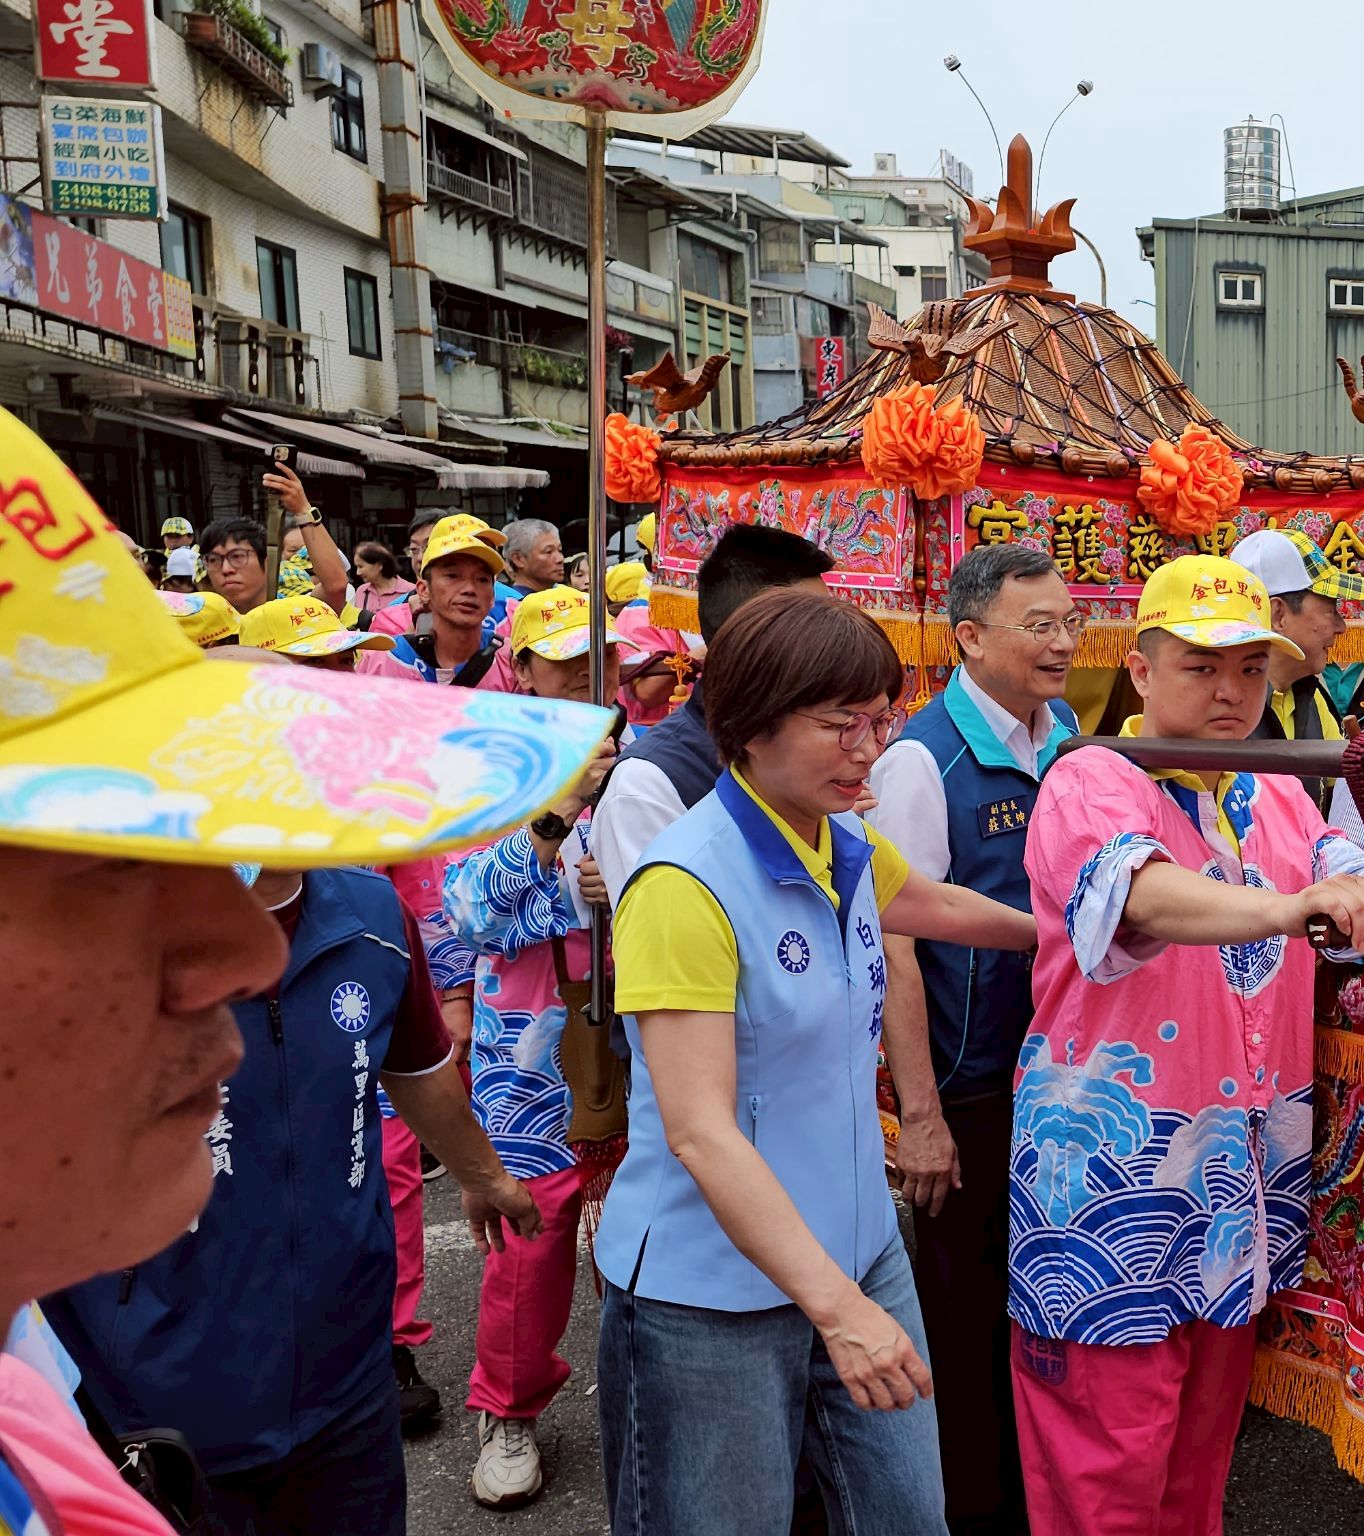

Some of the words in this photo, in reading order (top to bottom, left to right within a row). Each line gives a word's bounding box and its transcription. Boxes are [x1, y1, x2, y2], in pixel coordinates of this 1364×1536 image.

[49, 0, 134, 78] 堂
[51, 104, 147, 124] 台菜海鮮
[53, 142, 150, 163] 經濟小吃
[58, 182, 150, 200] 2498-6458
[45, 231, 164, 340] 兄弟食堂
[820, 338, 842, 399] 東岸
[1191, 577, 1262, 610] 金包里媽
